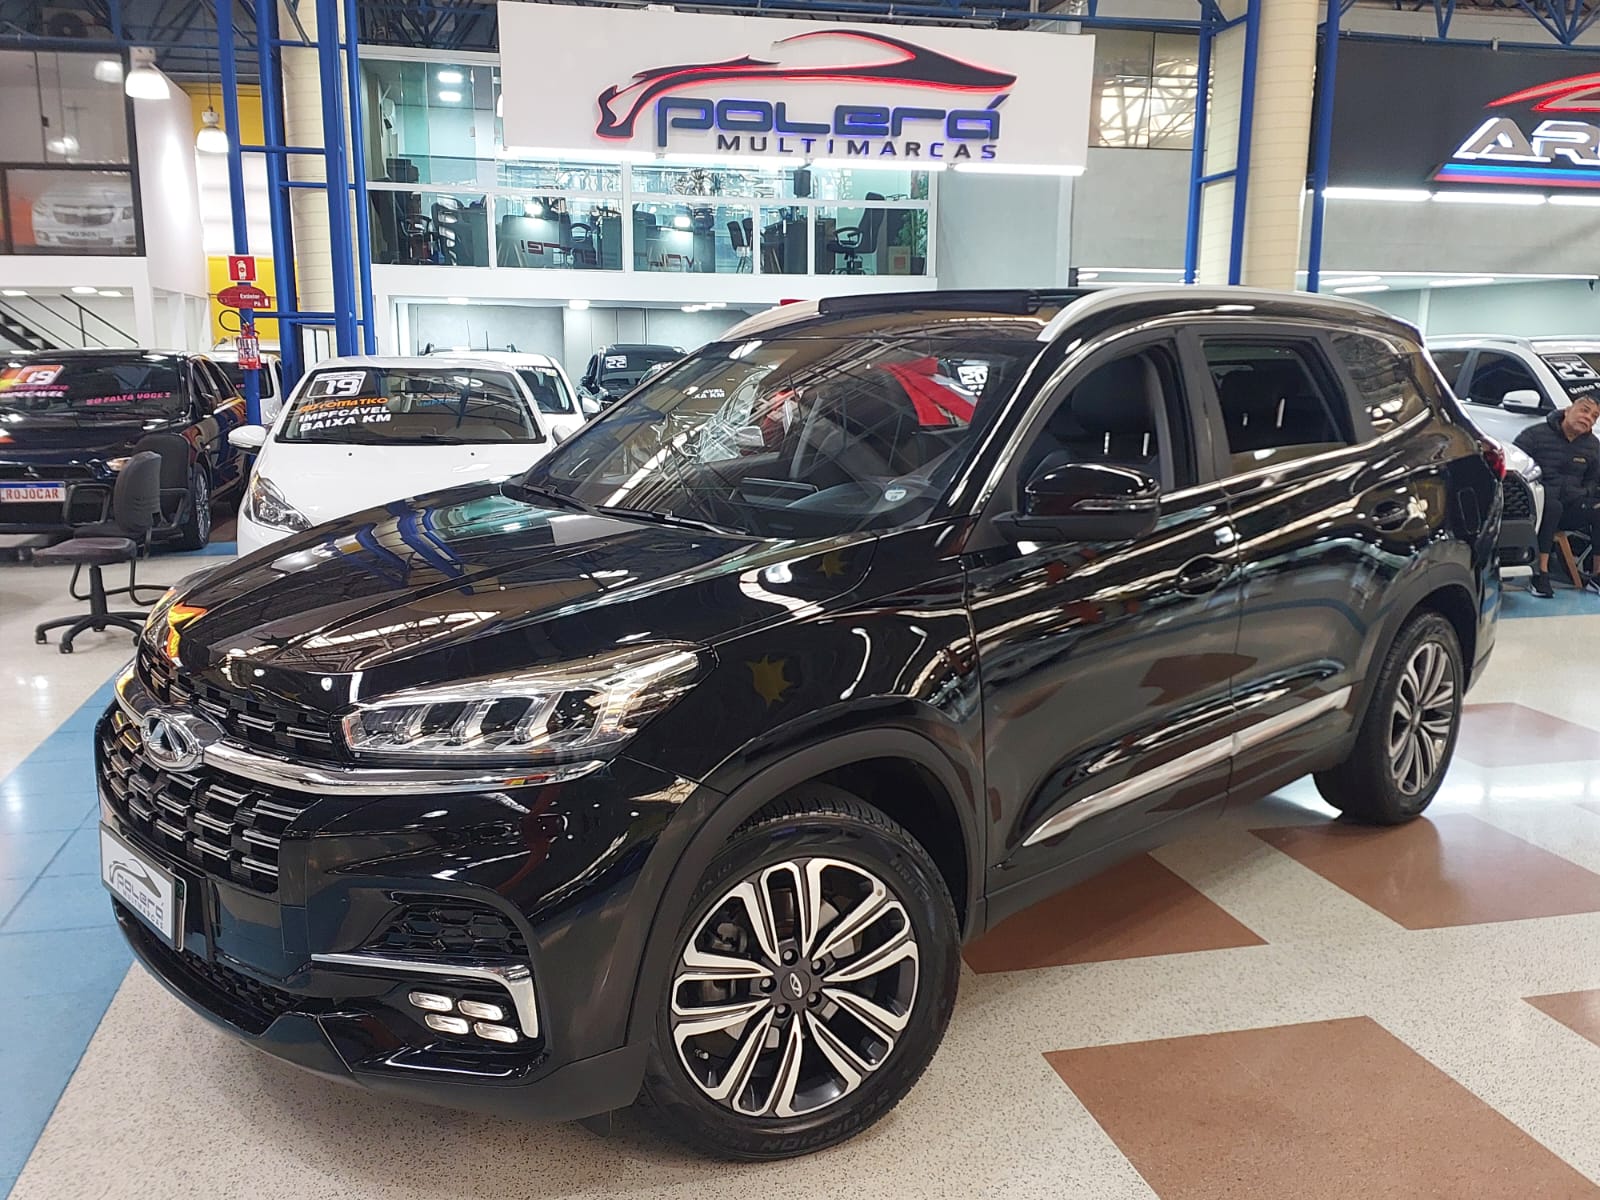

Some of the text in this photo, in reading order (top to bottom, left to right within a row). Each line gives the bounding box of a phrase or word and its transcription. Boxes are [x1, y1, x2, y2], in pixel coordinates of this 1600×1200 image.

[716, 134, 998, 160] MULTIMARCAS
[1452, 117, 1600, 166] AR
[25, 370, 55, 385] 19
[1553, 361, 1596, 378] 25
[325, 378, 360, 396] 19
[300, 413, 392, 432] BAIXA KM
